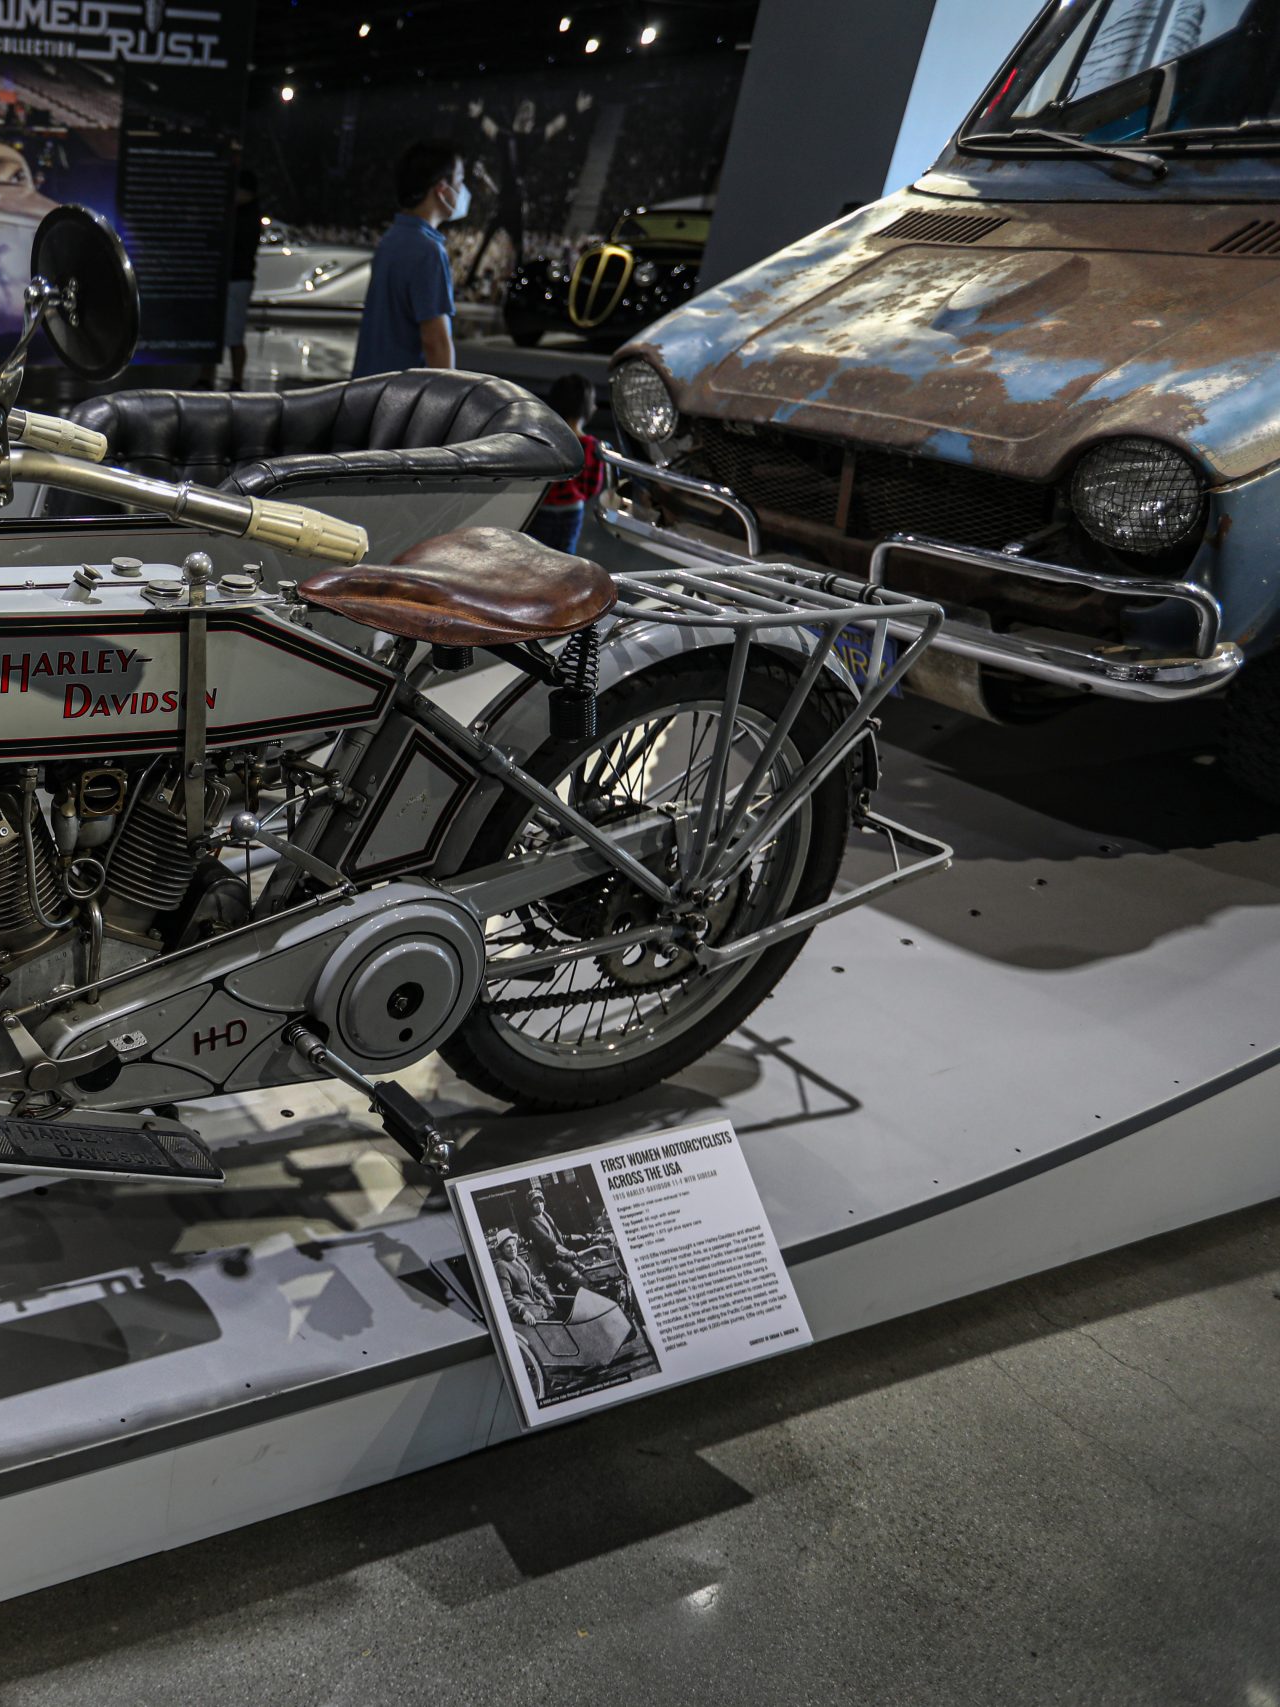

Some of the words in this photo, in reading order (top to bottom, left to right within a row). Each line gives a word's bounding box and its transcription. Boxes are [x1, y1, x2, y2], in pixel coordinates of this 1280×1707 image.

[0, 648, 153, 694] HARLEY-
[63, 683, 218, 719] DAVIDSN
[56, 1143, 162, 1165] DAVIDSON
[599, 1155, 627, 1173] FIRST
[626, 1147, 661, 1166] WOMEN
[660, 1130, 732, 1158] MOTORCYCLISTS
[606, 1170, 644, 1190] ACROSS
[643, 1165, 663, 1181] THE
[662, 1161, 682, 1176] USA
[625, 1180, 671, 1197] HARLEY-DAVIDSON
[683, 1174, 696, 1183] WITH
[696, 1169, 717, 1180] SIDECAR
